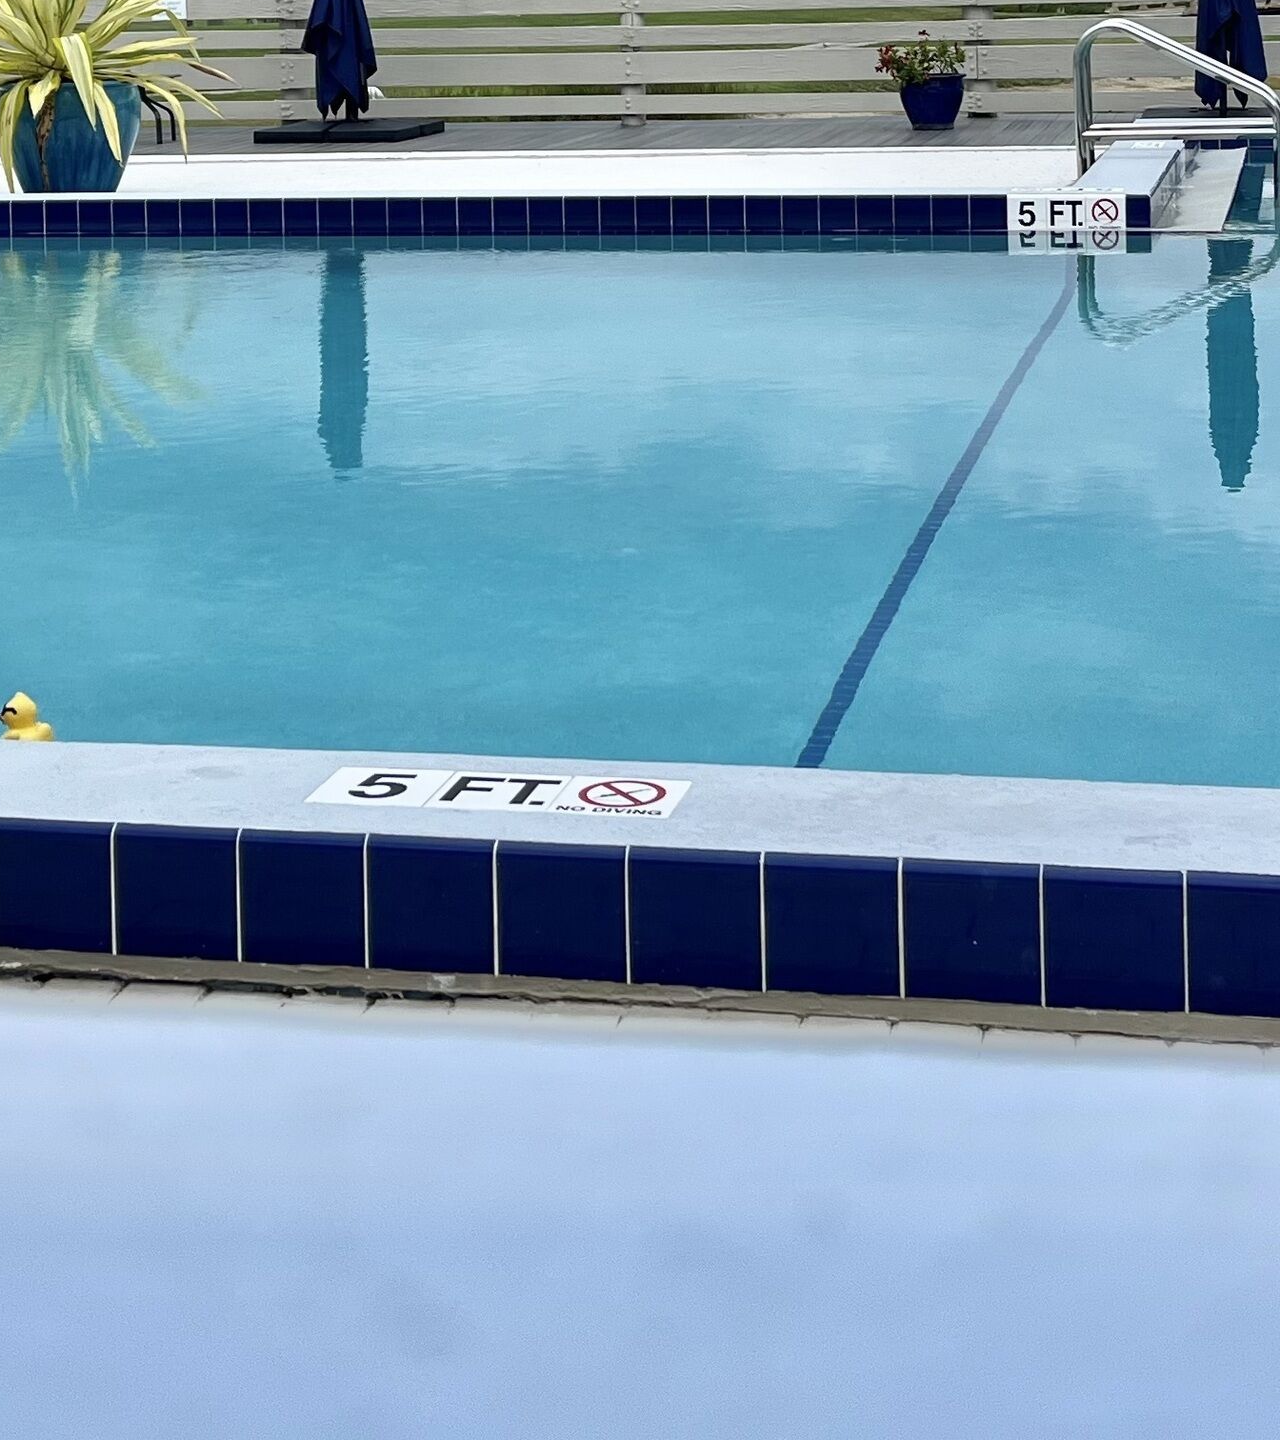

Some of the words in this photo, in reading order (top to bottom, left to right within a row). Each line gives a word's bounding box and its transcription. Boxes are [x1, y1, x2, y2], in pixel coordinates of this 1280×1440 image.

[1018, 201, 1036, 226] 5
[1050, 200, 1083, 226] FT.
[347, 773, 418, 799] 5
[438, 775, 562, 806] FT.
[591, 806, 662, 815] DIVING
